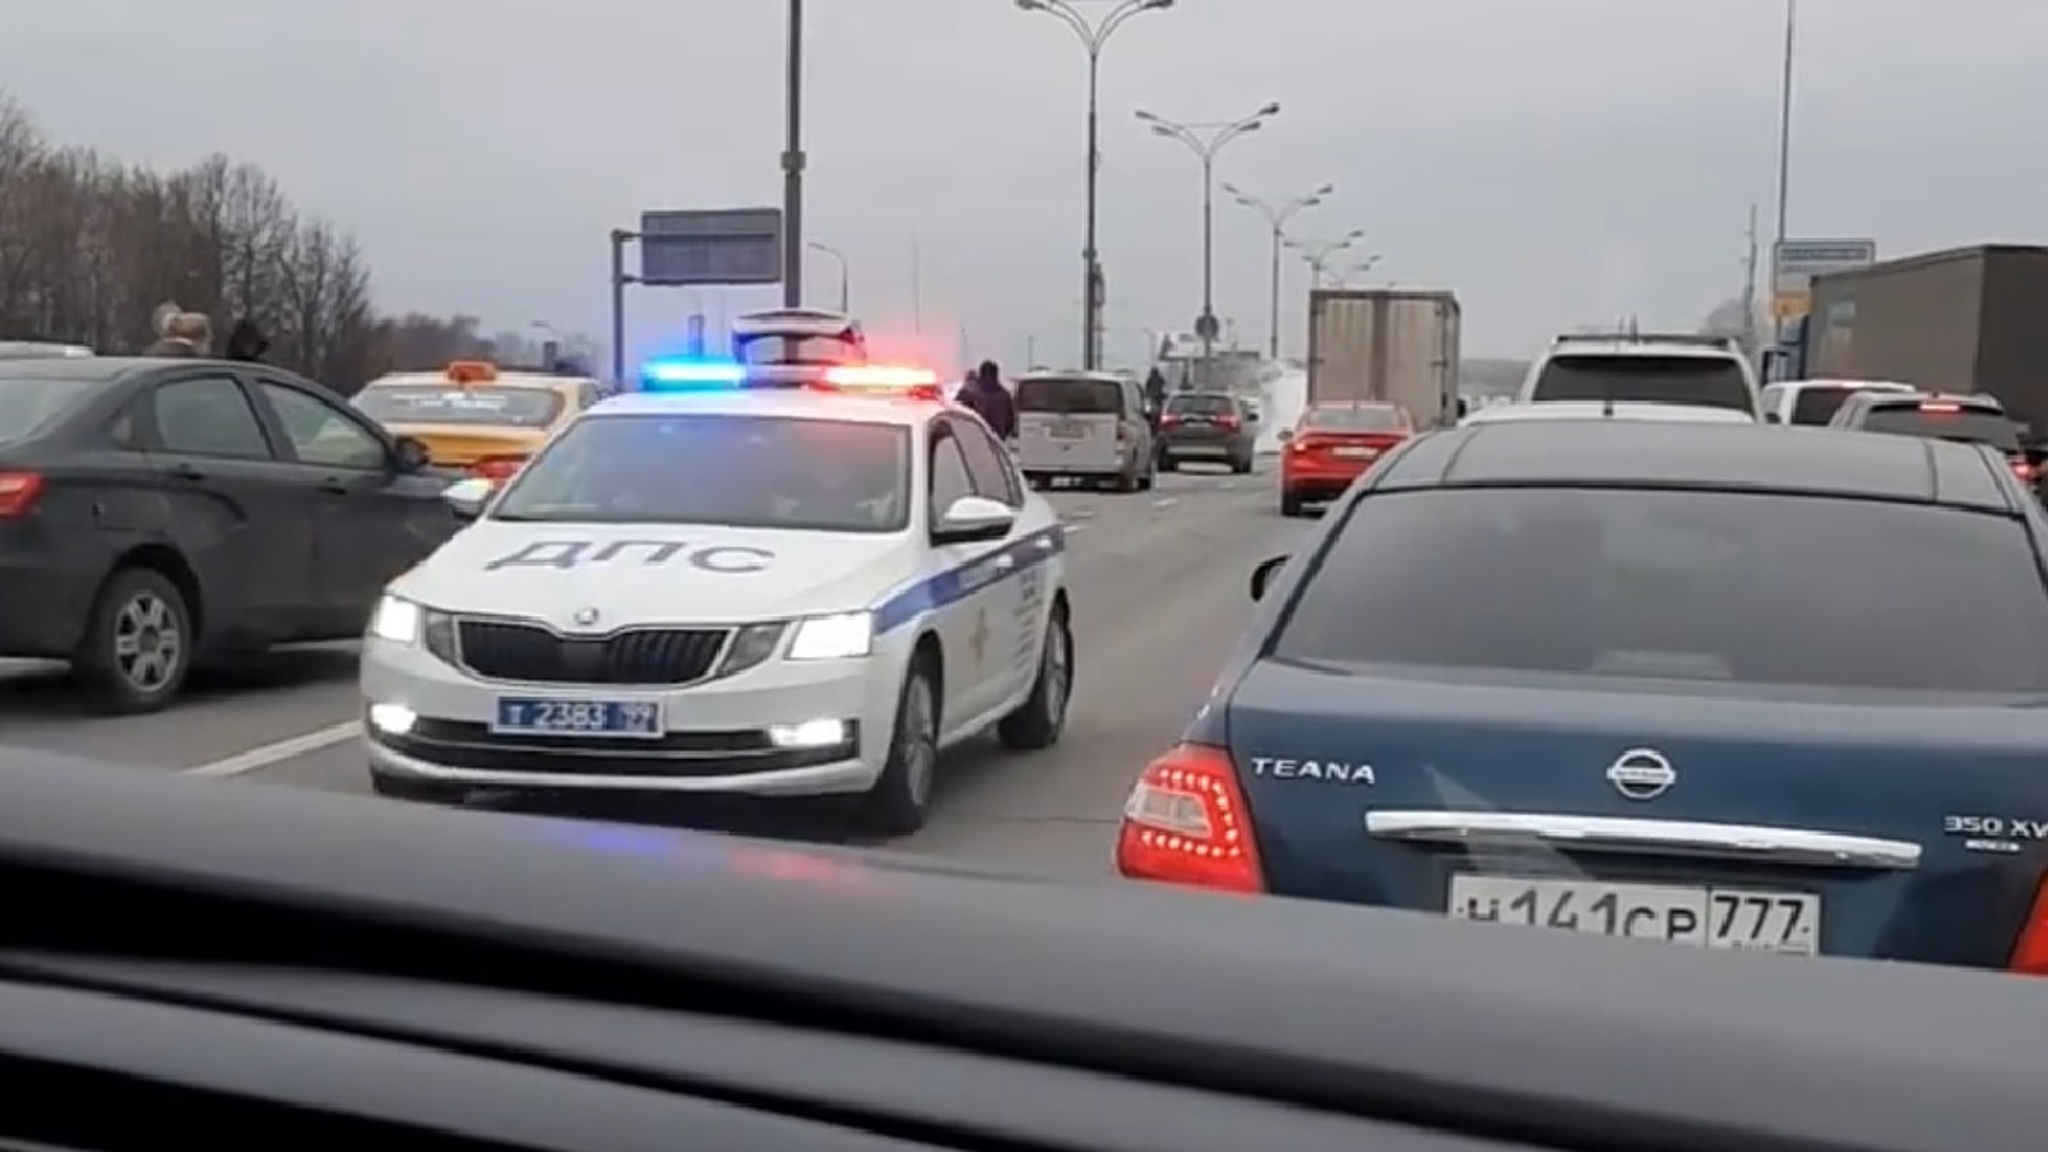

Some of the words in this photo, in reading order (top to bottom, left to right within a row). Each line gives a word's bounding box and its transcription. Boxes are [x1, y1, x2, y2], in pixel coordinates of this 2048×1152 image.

[483, 541, 776, 573] ДПС
[535, 703, 606, 727] 2383
[1250, 757, 1375, 785] TEANA
[1943, 815, 2003, 836] 350
[1715, 896, 1803, 940] 777
